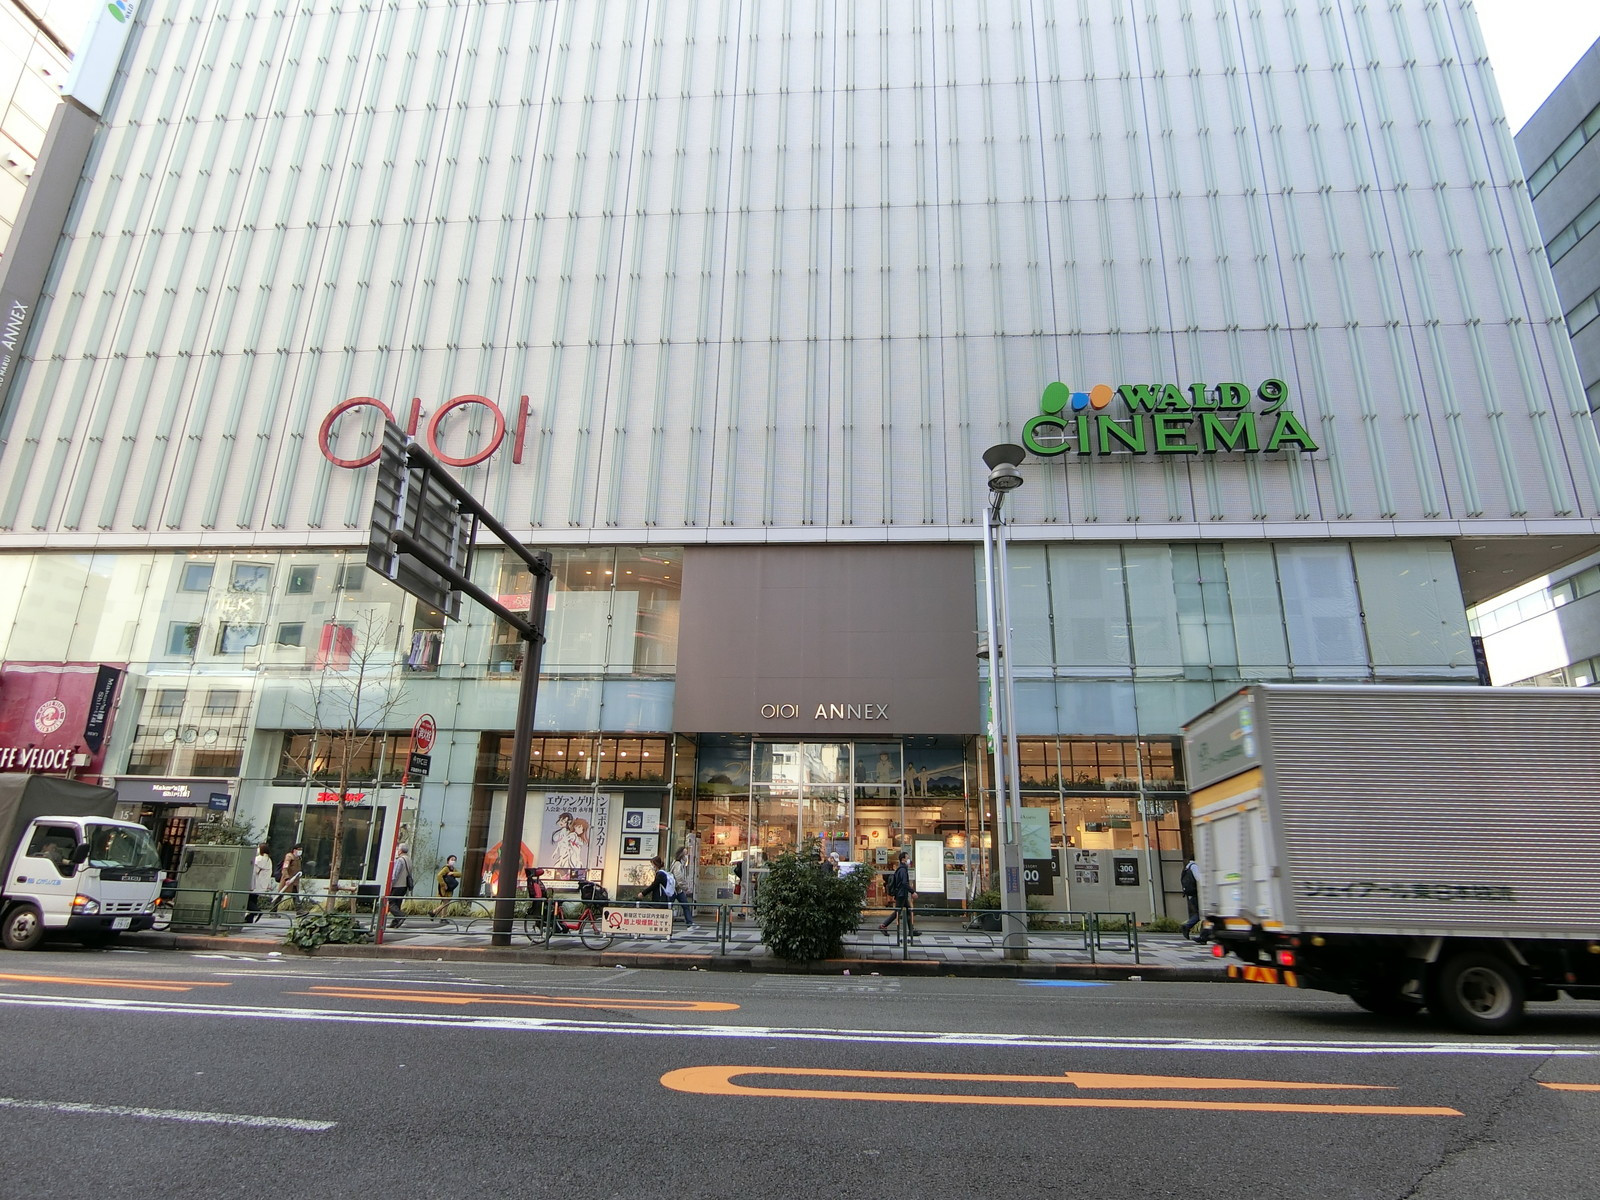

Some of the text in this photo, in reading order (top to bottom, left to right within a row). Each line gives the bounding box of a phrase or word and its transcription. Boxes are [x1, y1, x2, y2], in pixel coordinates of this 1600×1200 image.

[2, 300, 28, 351] ANNEX
[1117, 378, 1289, 415] WALD 9
[1022, 411, 1320, 457] CINEMA
[814, 703, 889, 720] ANNEX
[22, 748, 71, 769] VELOCE
[596, 807, 608, 867] エポスカード
